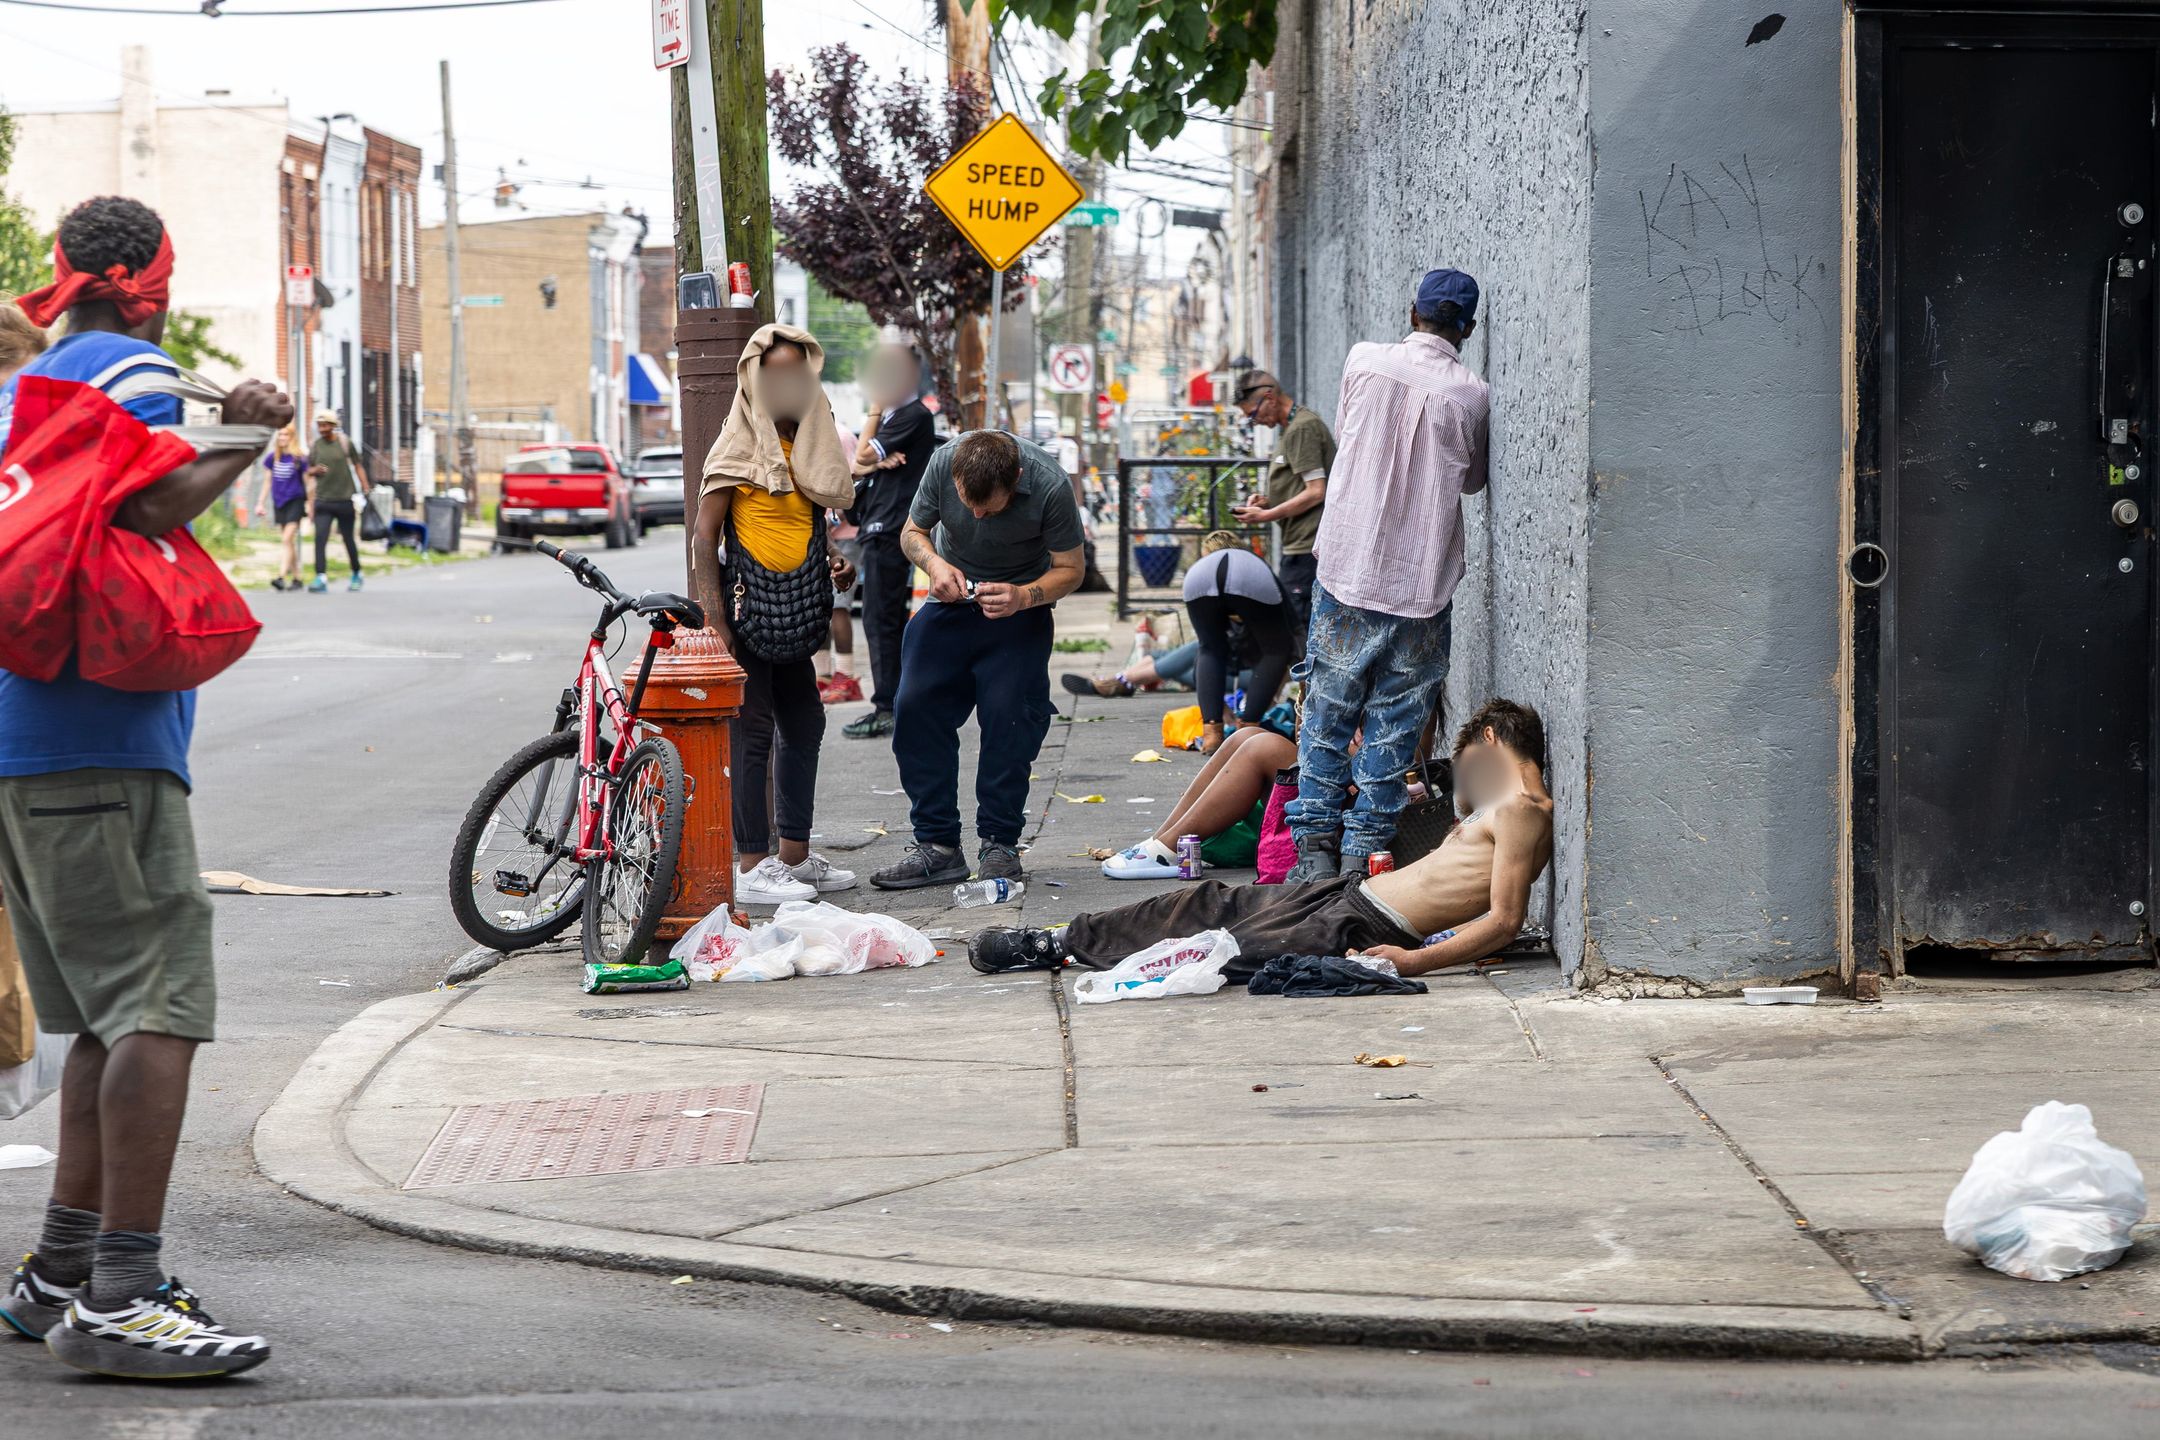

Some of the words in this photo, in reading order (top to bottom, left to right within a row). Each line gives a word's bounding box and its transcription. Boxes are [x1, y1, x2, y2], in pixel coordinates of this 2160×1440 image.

[660, 8, 680, 35] TIME
[966, 162, 1045, 188] SPEED
[968, 198, 1039, 223] HUMP
[579, 676, 592, 765] ROADMA
